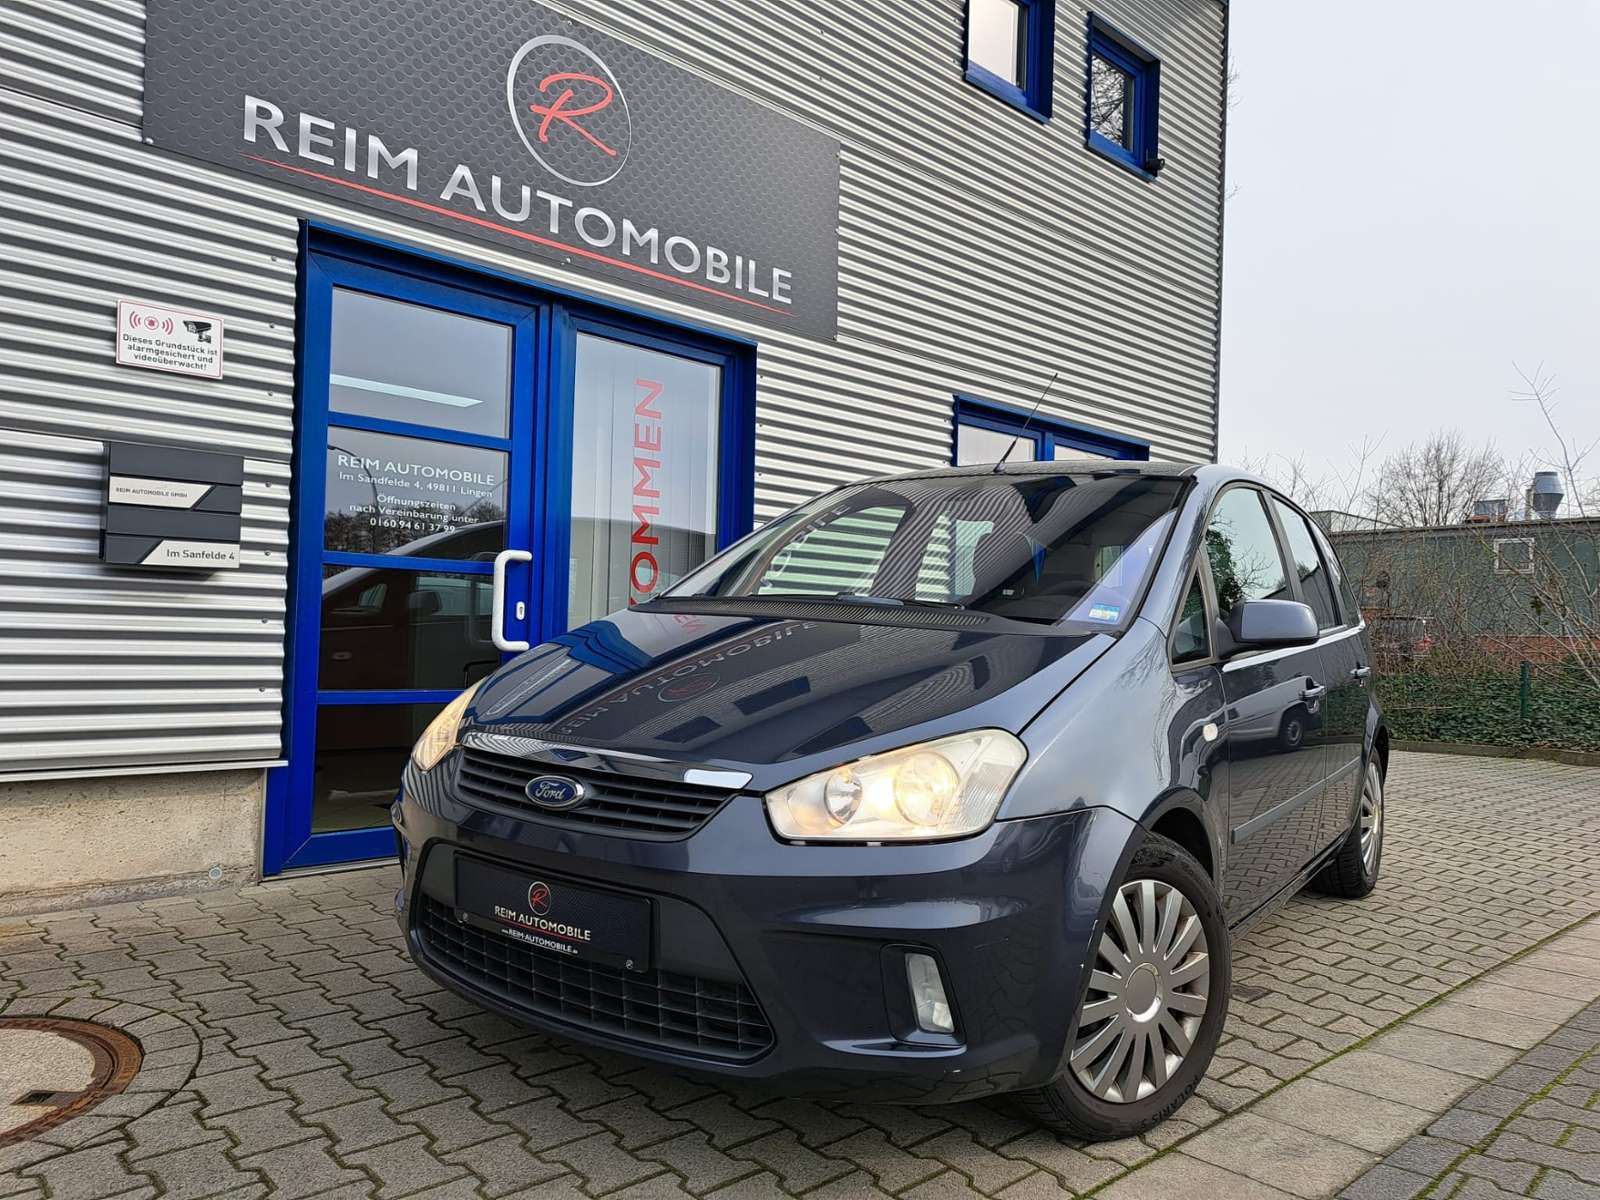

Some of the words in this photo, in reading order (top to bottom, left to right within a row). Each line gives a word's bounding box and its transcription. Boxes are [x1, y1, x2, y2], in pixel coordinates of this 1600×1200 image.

[530, 72, 618, 158] R
[243, 94, 419, 192] REIM
[439, 163, 793, 306] AUTOMOBILE
[122, 333, 153, 345] Dieses
[155, 339, 205, 354] Grundstück
[127, 343, 195, 360] alarmgesichert
[197, 354, 214, 364] und
[133, 353, 207, 370] videoüberwacht!
[337, 454, 380, 471] REIM
[384, 461, 496, 486] AUTOMOBILE
[131, 488, 171, 497] AUTOMOBILE
[339, 471, 354, 482] Im
[357, 474, 411, 488] Sandfelde
[413, 480, 424, 491] 4,
[426, 482, 457, 494] 49811
[460, 487, 494, 499] Lingen
[630, 377, 665, 606] OMMEN
[376, 491, 457, 512] Öffnungszeiten
[349, 504, 376, 514] nach
[377, 506, 450, 524] Vereinbarung
[451, 514, 480, 524] unter
[369, 518, 397, 529] 0160
[398, 520, 412, 530] 94
[413, 521, 426, 531] 61
[429, 522, 443, 532] 37
[166, 548, 181, 558] Im
[182, 549, 227, 561] Sanfelde
[228, 551, 236, 560] 4
[535, 780, 567, 800] Ford
[494, 905, 517, 921] REIM
[518, 914, 592, 940] AUTOMOBILE
